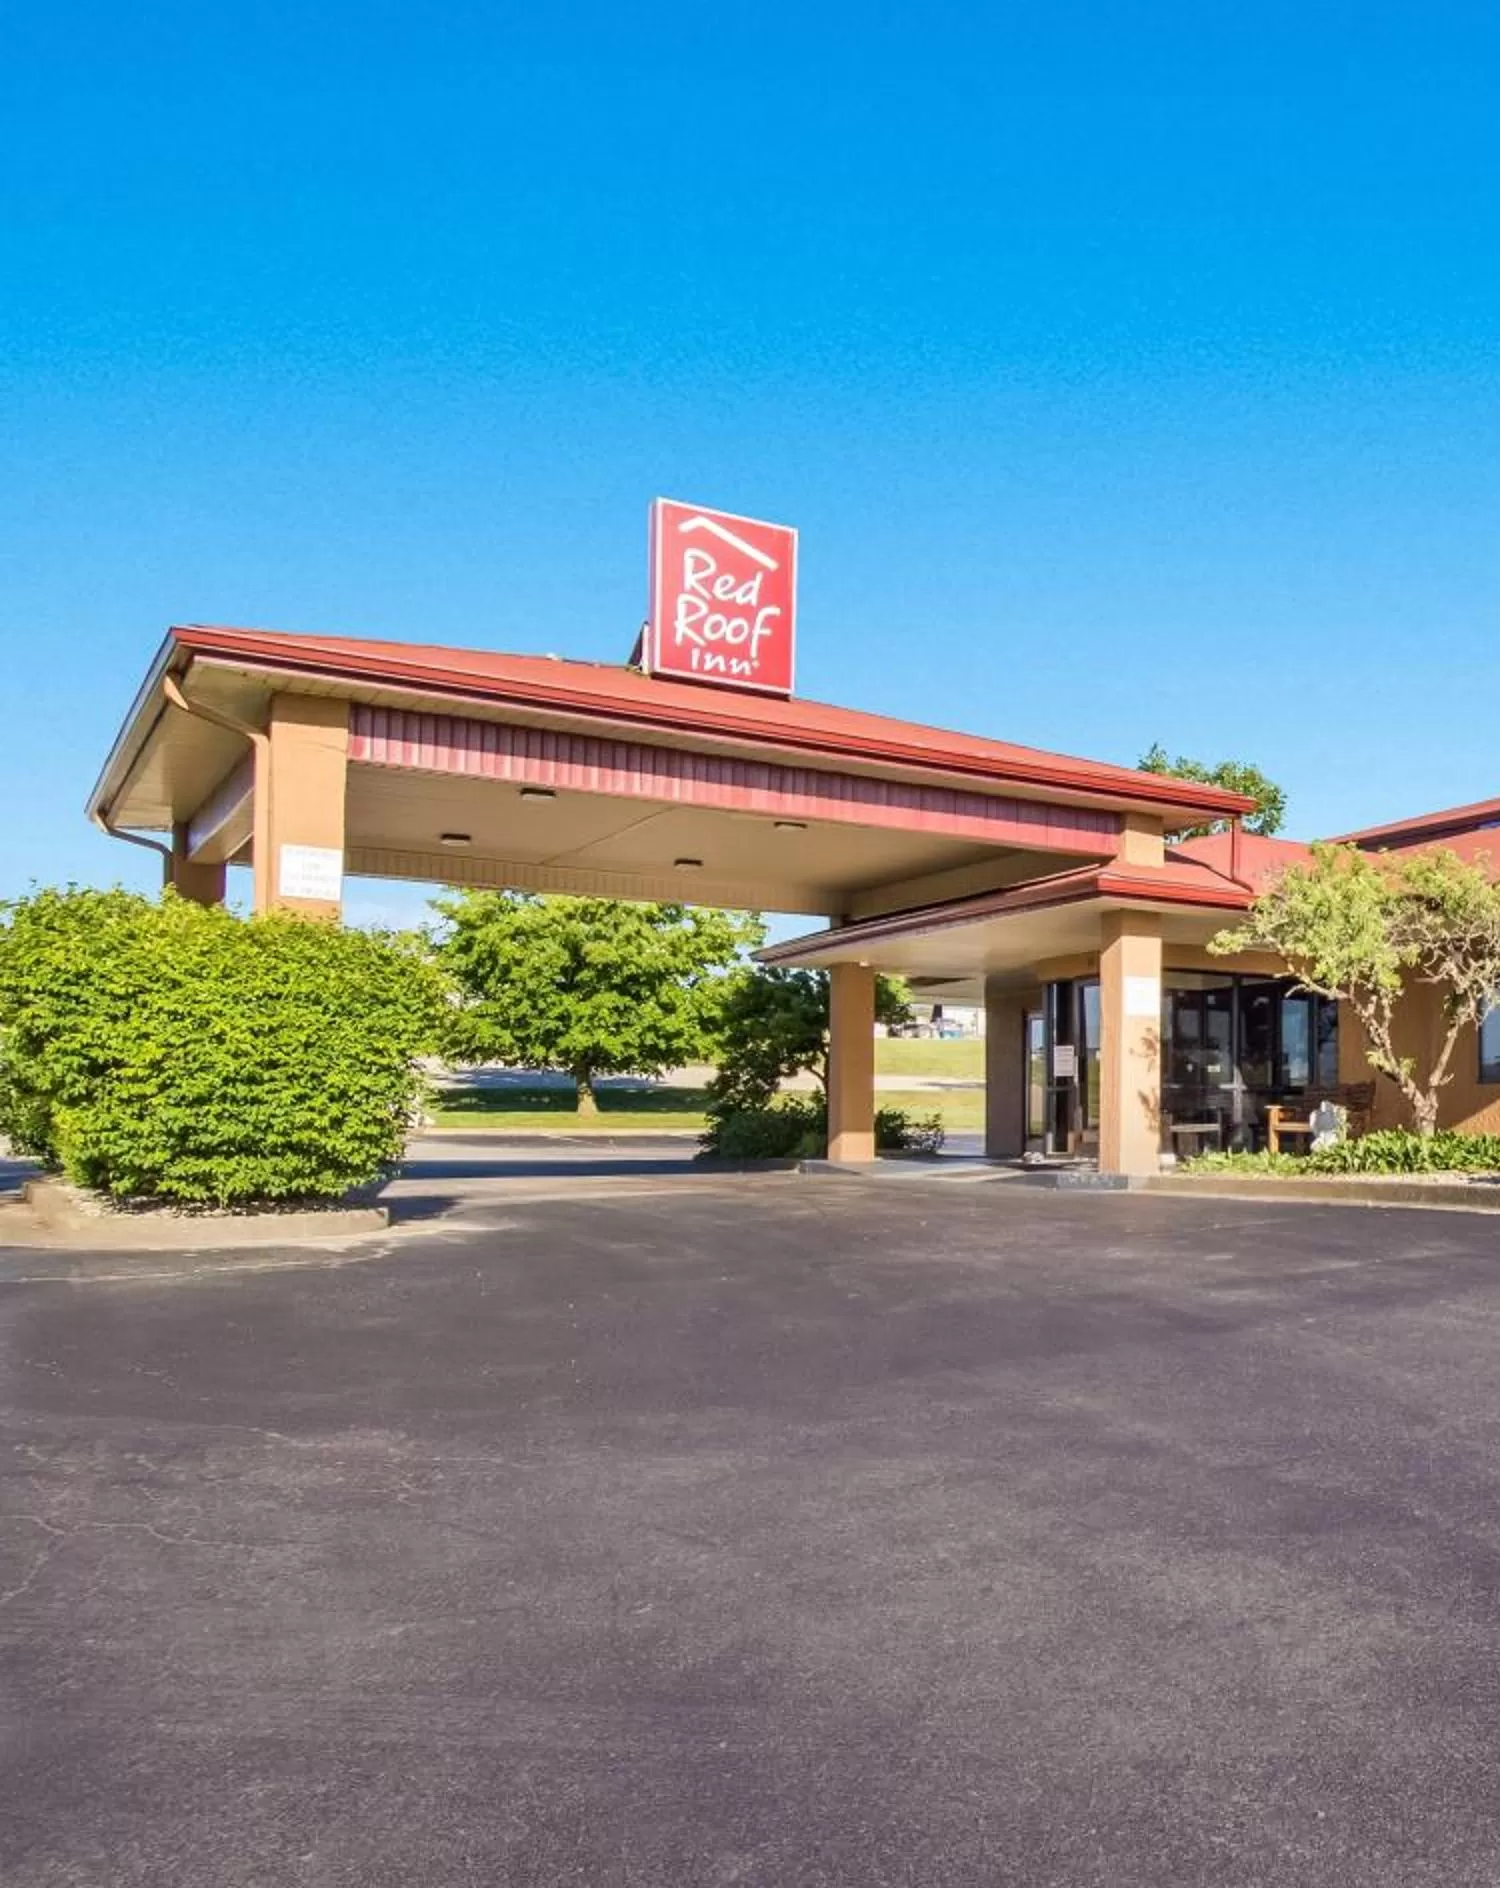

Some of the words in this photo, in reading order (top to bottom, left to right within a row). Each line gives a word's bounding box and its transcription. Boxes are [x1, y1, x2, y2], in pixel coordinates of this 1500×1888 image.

[684, 547, 764, 607] Red
[674, 593, 781, 658] Roof
[691, 648, 753, 675] Inn
